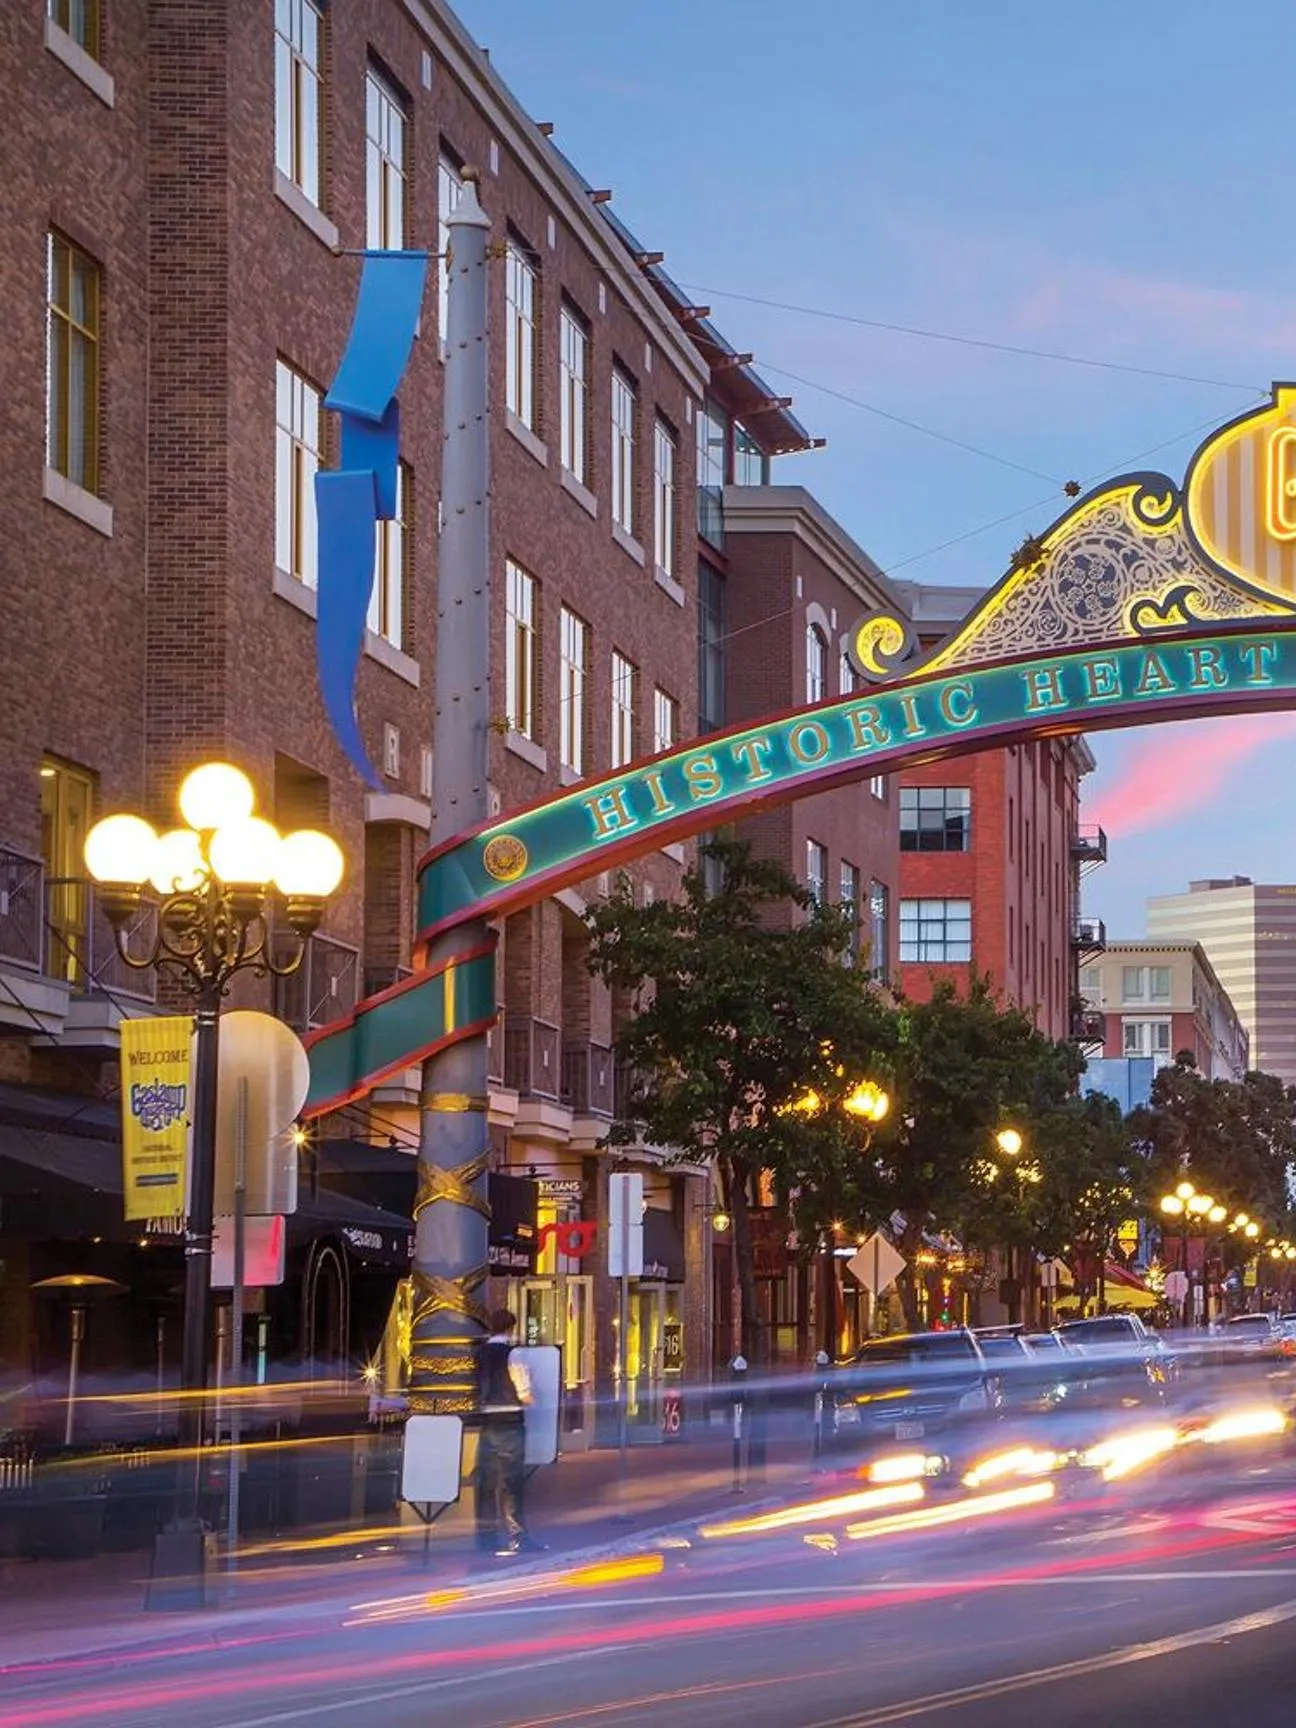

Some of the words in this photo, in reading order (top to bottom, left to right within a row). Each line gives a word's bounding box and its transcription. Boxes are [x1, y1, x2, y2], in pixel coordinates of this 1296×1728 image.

[584, 681, 979, 841] HISTORIC
[1020, 640, 1279, 713] HEART
[128, 1049, 189, 1067] WELCOME
